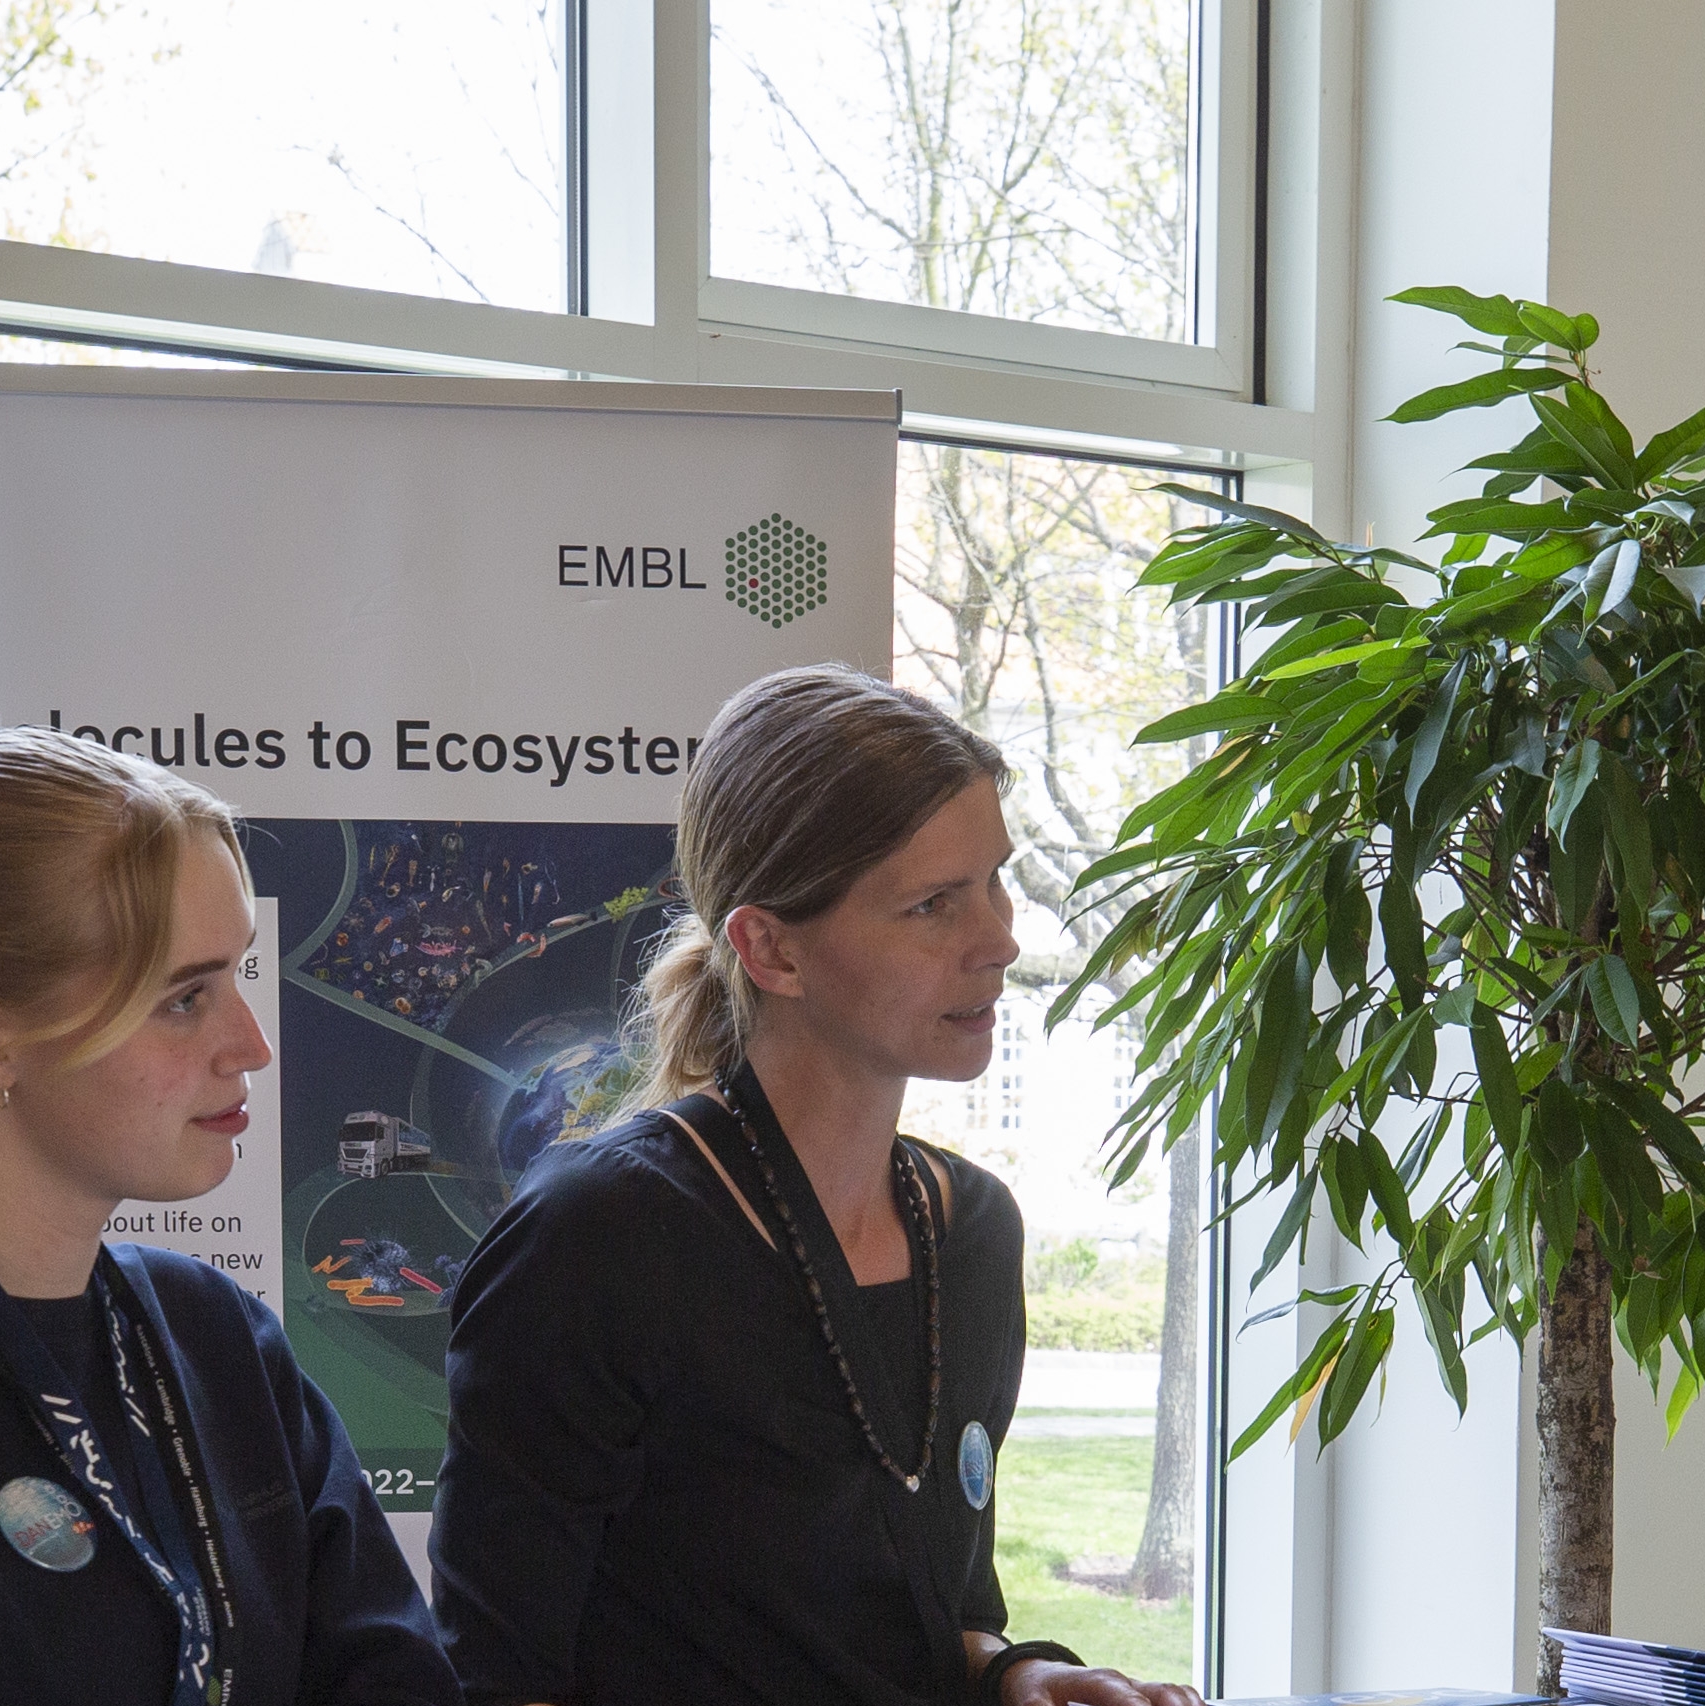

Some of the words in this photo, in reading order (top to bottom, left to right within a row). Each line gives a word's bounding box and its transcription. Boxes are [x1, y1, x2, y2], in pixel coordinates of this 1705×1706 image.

[557, 543, 708, 590] EMBL
[308, 720, 372, 770] to
[164, 1210, 203, 1233] life
[211, 1216, 242, 1233] on
[211, 1253, 263, 1270] new
[155, 1377, 176, 1426] Cambridge
[172, 1436, 192, 1479] Grenoble
[190, 1486, 208, 1529] Hamburg
[205, 1538, 226, 1589] Heidelberg
